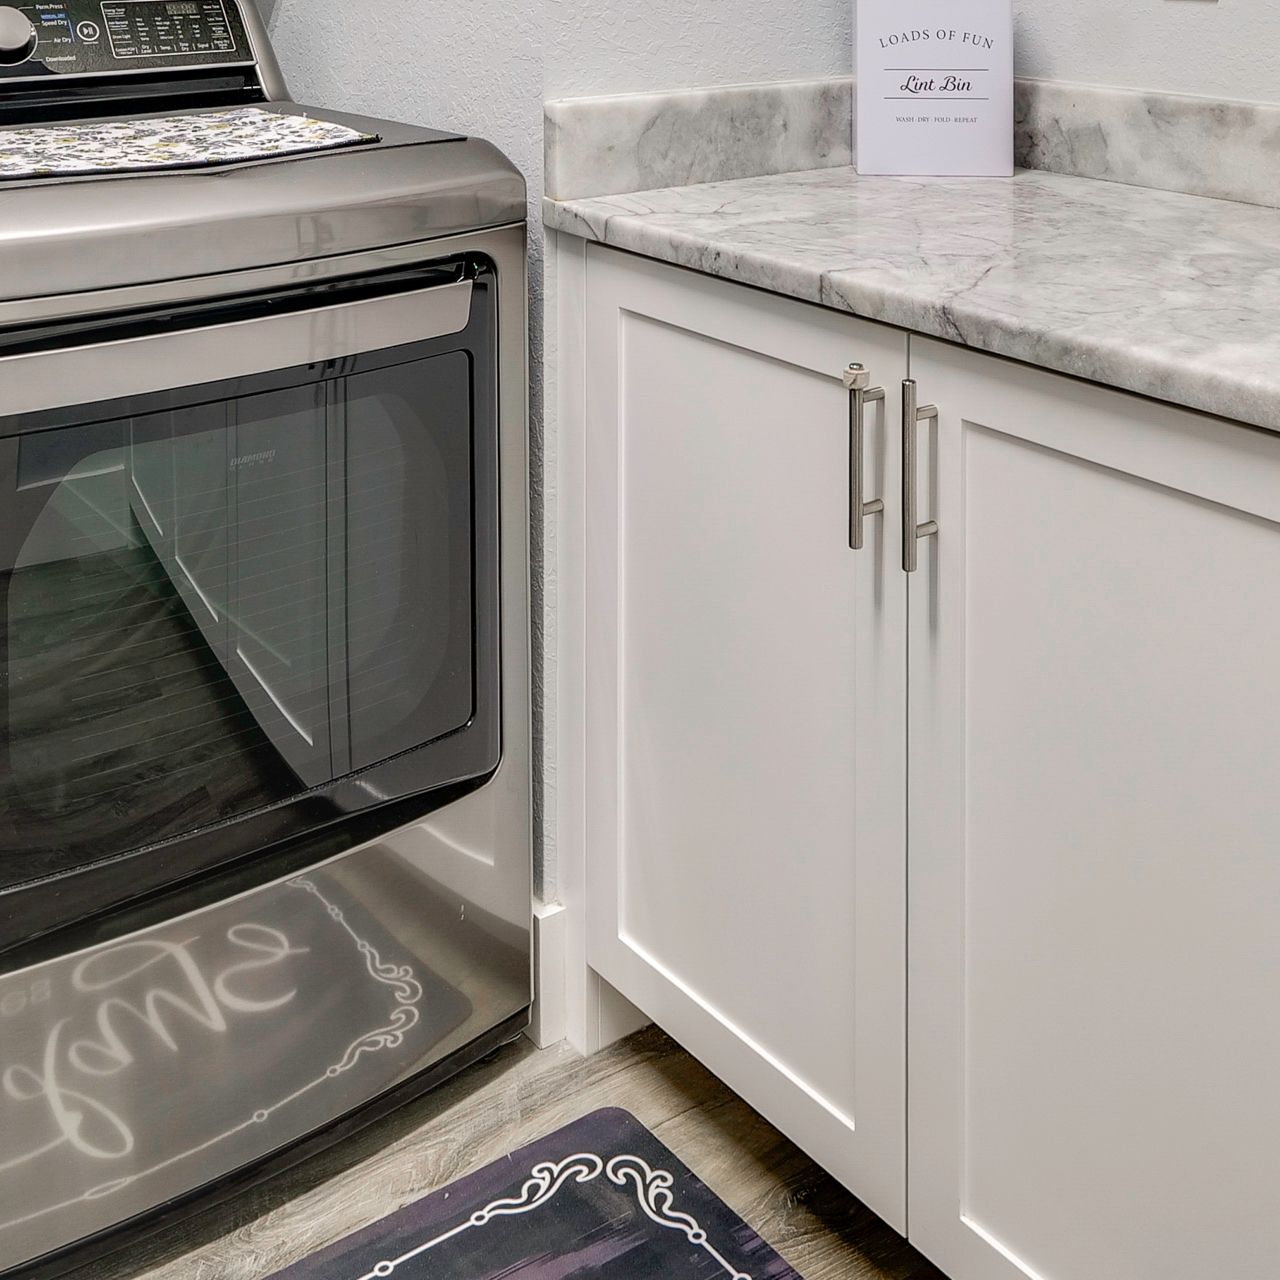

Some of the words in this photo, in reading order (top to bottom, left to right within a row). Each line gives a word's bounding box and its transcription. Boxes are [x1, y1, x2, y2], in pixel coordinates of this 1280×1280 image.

[879, 29, 930, 49] LOADS
[936, 29, 956, 41] OF
[962, 32, 994, 49] FUN
[900, 75, 936, 94] Lint
[939, 75, 972, 92] Bin
